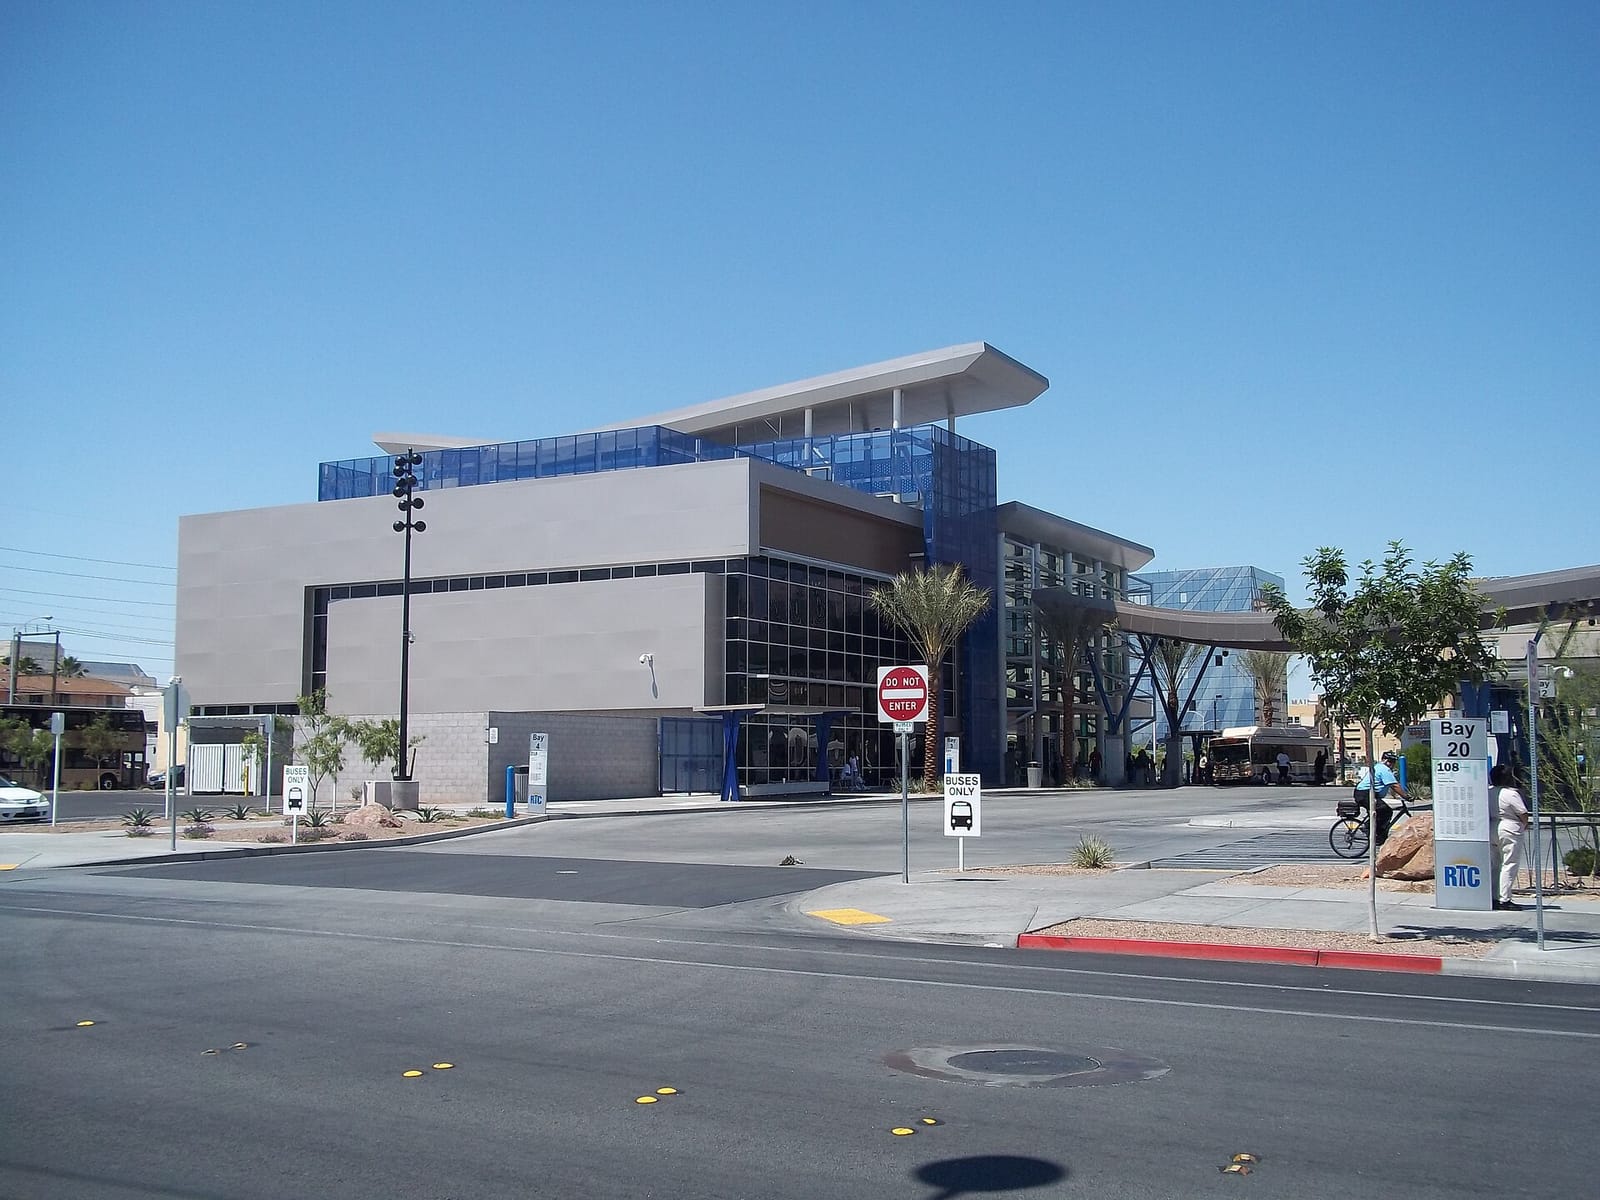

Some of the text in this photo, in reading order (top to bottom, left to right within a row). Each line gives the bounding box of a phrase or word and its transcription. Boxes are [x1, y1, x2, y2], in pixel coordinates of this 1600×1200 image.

[886, 677, 920, 687] DO NOT
[889, 702, 917, 711] ENTER
[1441, 721, 1475, 739] Bay
[532, 733, 545, 743] Bay
[1447, 742, 1470, 757] 20
[285, 767, 307, 775] BUSES
[1437, 762, 1460, 772] 108
[287, 776, 305, 784] ONLY
[945, 776, 979, 786] BUSES
[949, 786, 975, 796] ONLY
[530, 794, 543, 805] RTC
[1444, 865, 1481, 888] RTC
